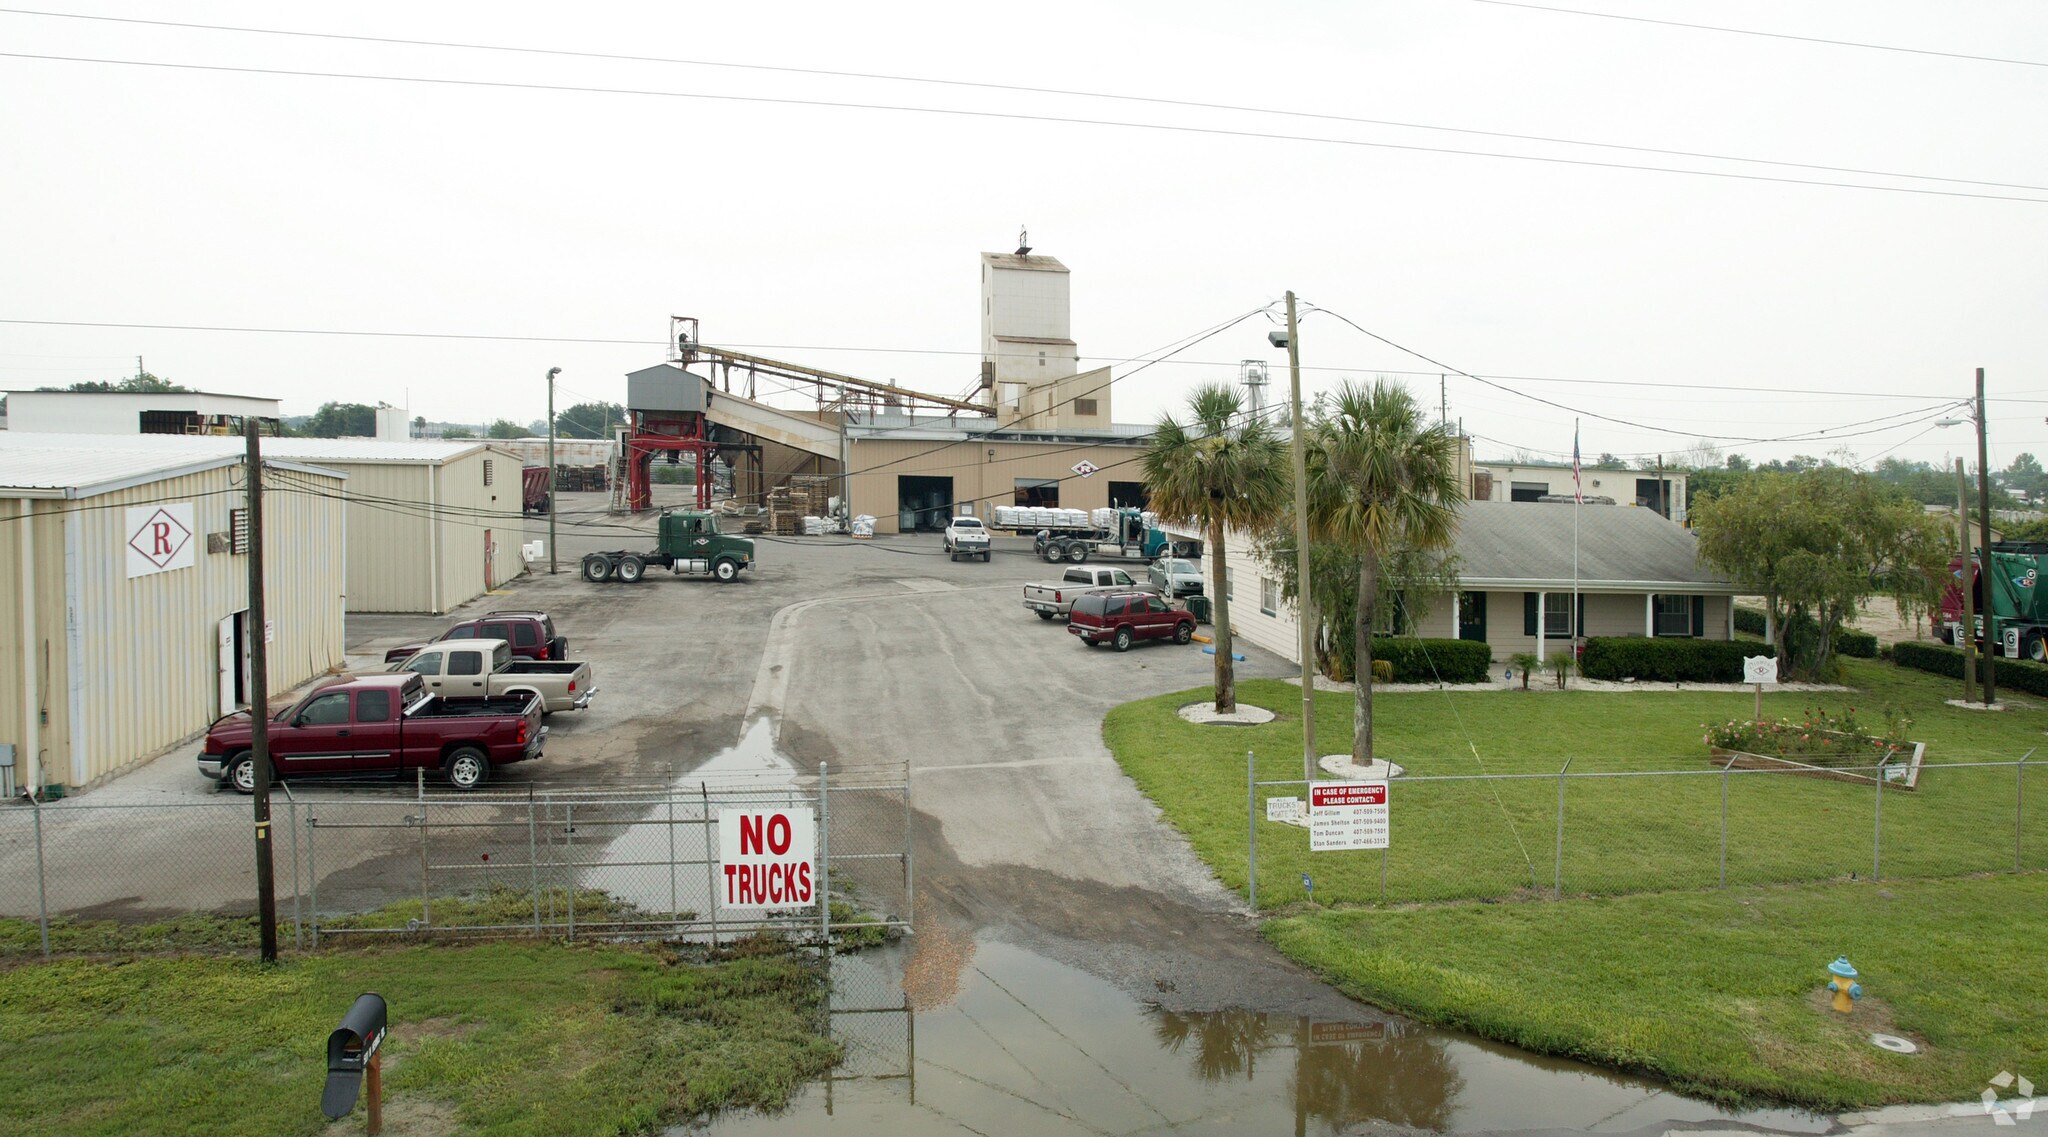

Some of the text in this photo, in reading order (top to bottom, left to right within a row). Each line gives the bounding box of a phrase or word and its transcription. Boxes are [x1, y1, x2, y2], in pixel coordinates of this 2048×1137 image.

[152, 522, 172, 556] R
[740, 814, 791, 855] NO
[724, 862, 811, 904] TRUCKS
